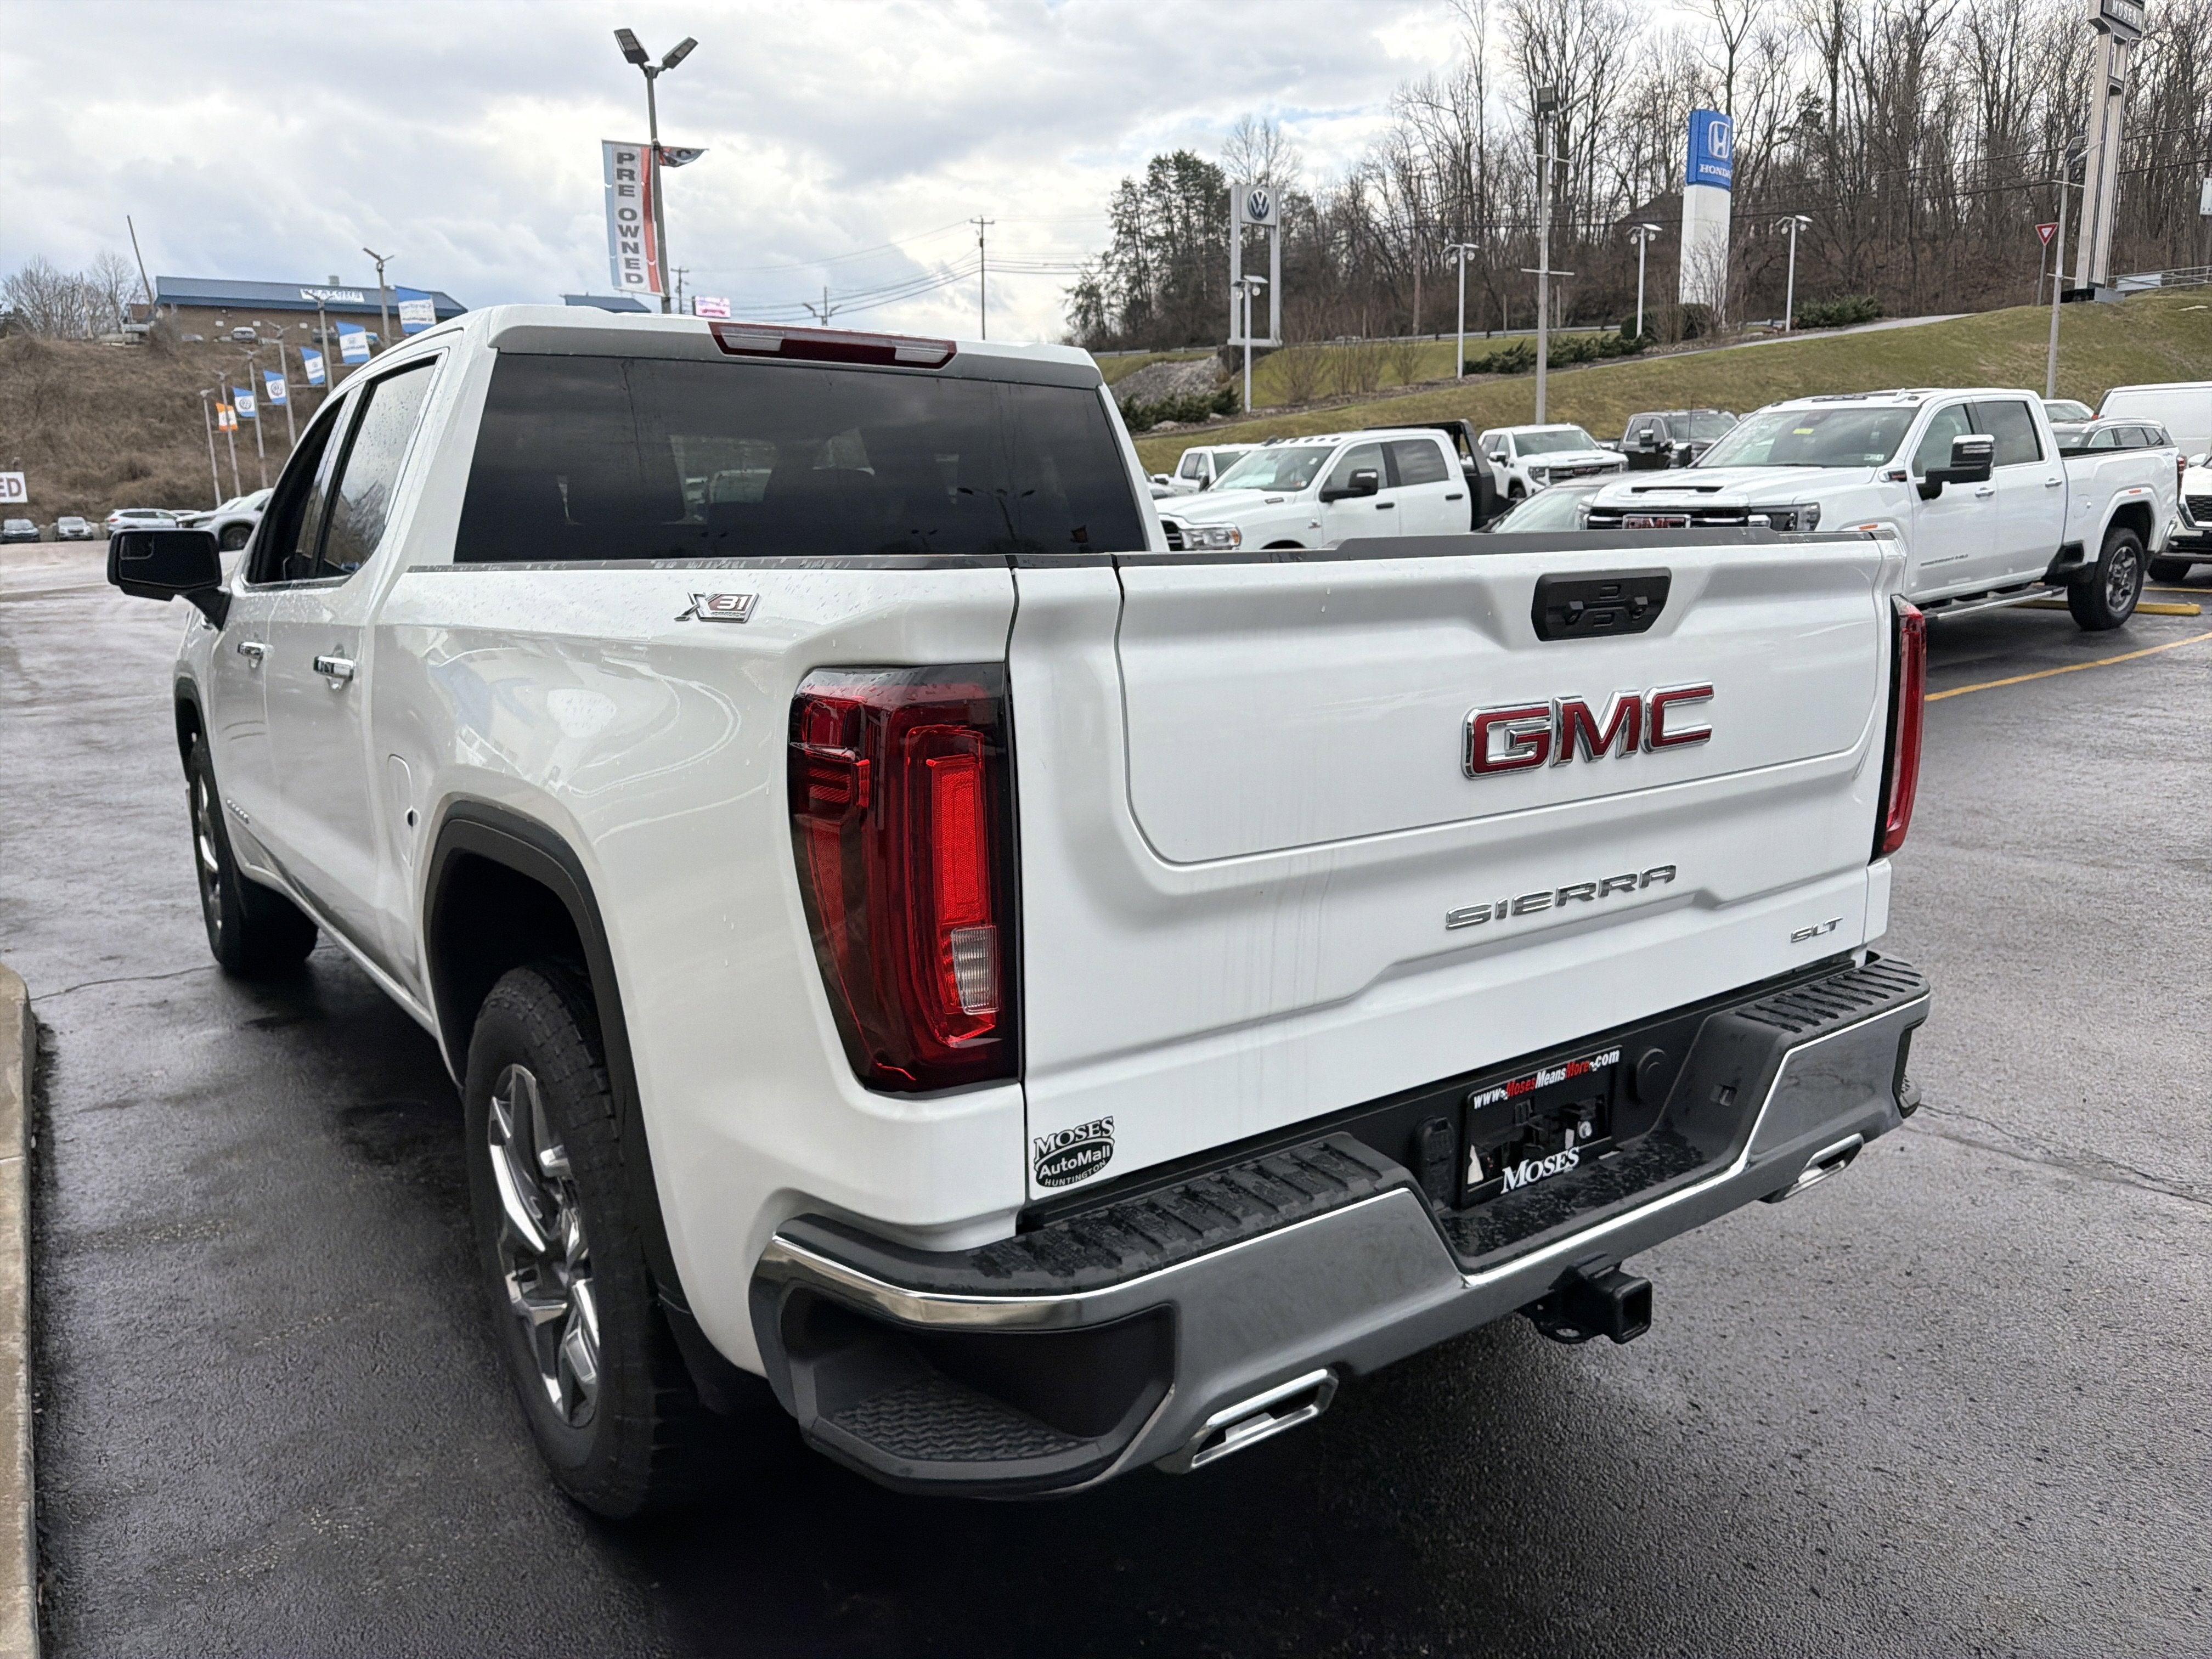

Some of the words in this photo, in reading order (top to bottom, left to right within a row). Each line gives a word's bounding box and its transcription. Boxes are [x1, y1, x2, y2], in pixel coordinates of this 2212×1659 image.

[2112, 0, 2137, 24] MOSES
[617, 152, 635, 197] PRE
[618, 207, 644, 284] OWNED
[1462, 681, 1714, 780] GMC
[1445, 864, 1677, 931] SIERRA
[1790, 916, 1844, 944] SLT
[1034, 1115, 1115, 1163] MOSES
[1039, 1144, 1110, 1179] AutoMall
[1045, 1160, 1107, 1186] HUNTINGTON
[1500, 1147, 1580, 1194] MOSES
